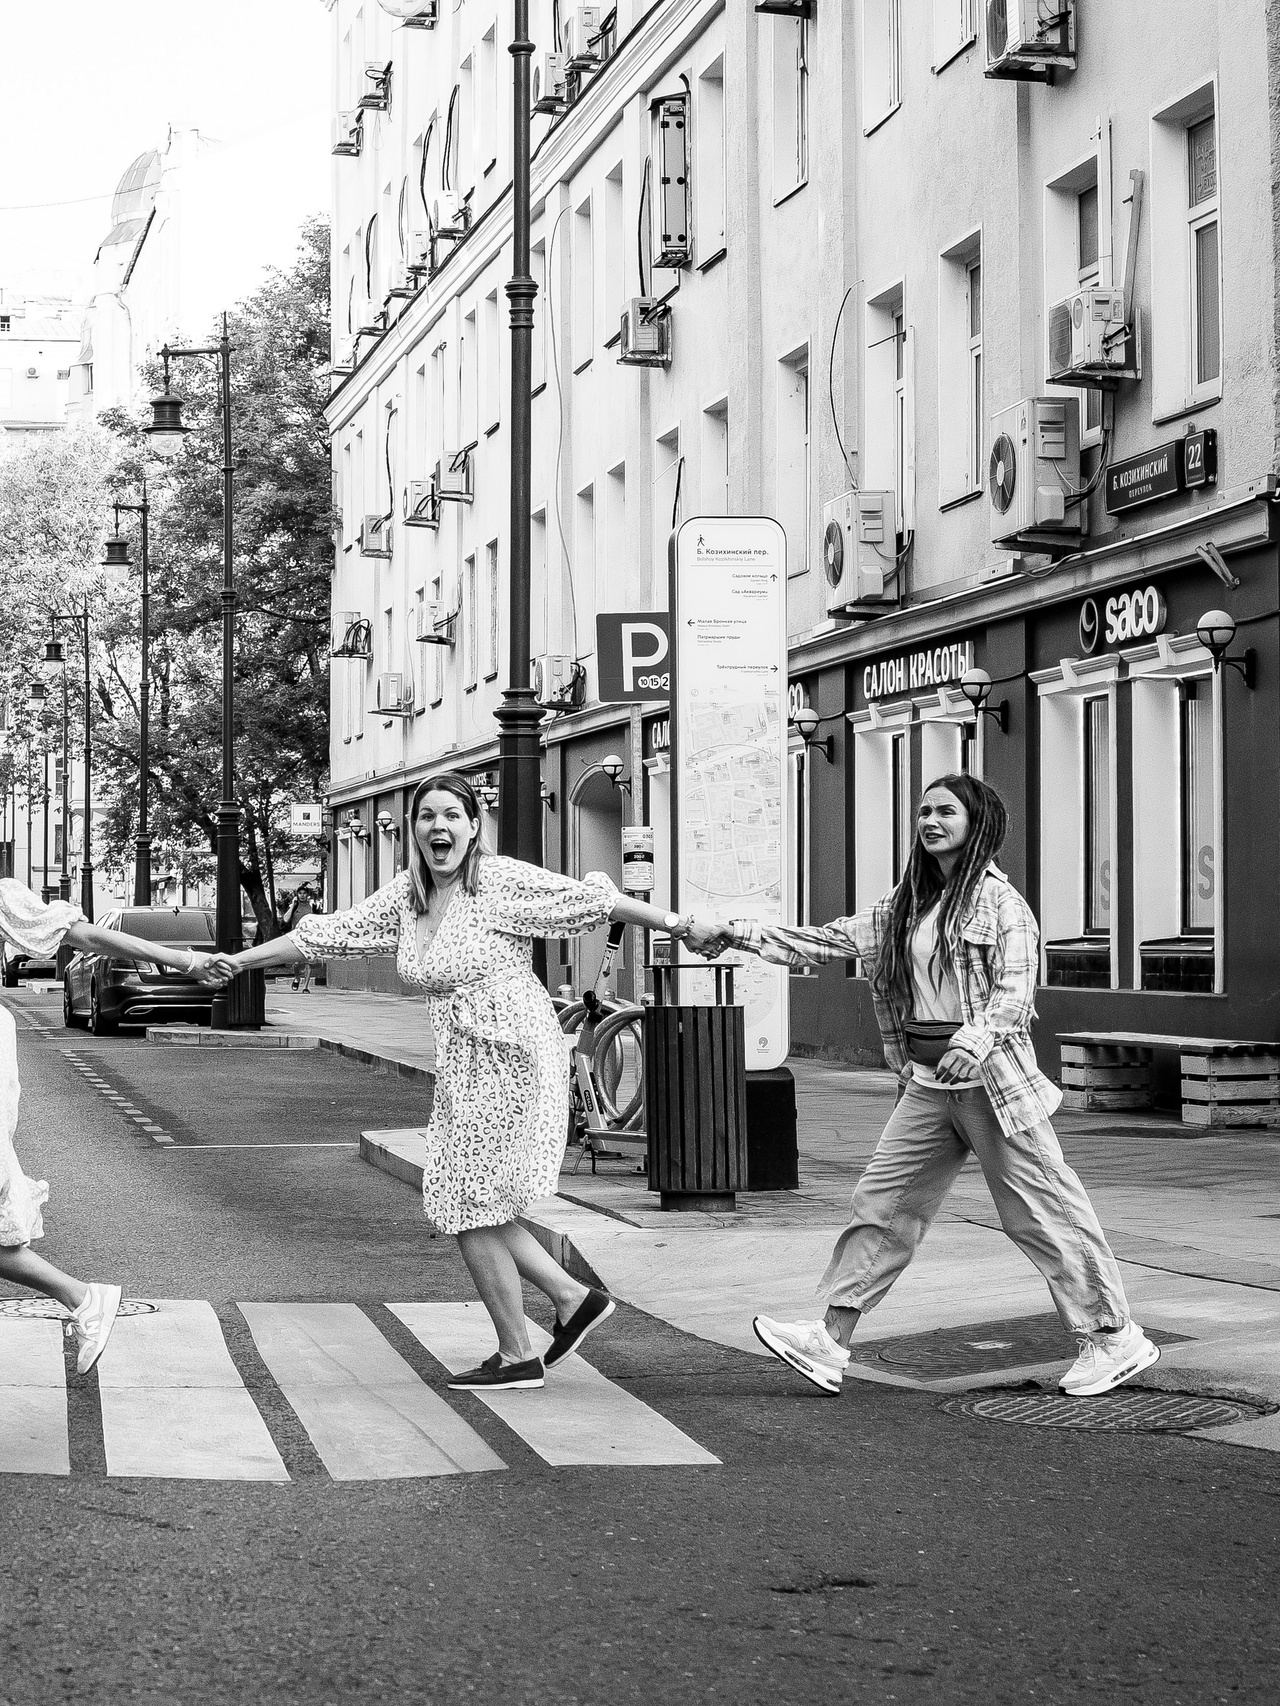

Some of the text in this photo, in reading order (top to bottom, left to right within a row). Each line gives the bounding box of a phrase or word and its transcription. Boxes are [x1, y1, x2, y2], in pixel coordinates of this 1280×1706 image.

[1113, 453, 1168, 491] Б. КОЗИХИНСКИЙ
[1188, 443, 1202, 470] 22
[1105, 585, 1159, 644] saco
[622, 622, 668, 692] P
[863, 641, 969, 699] САЛОН КРАСОТЫ
[640, 676, 669, 687] 10 15 2
